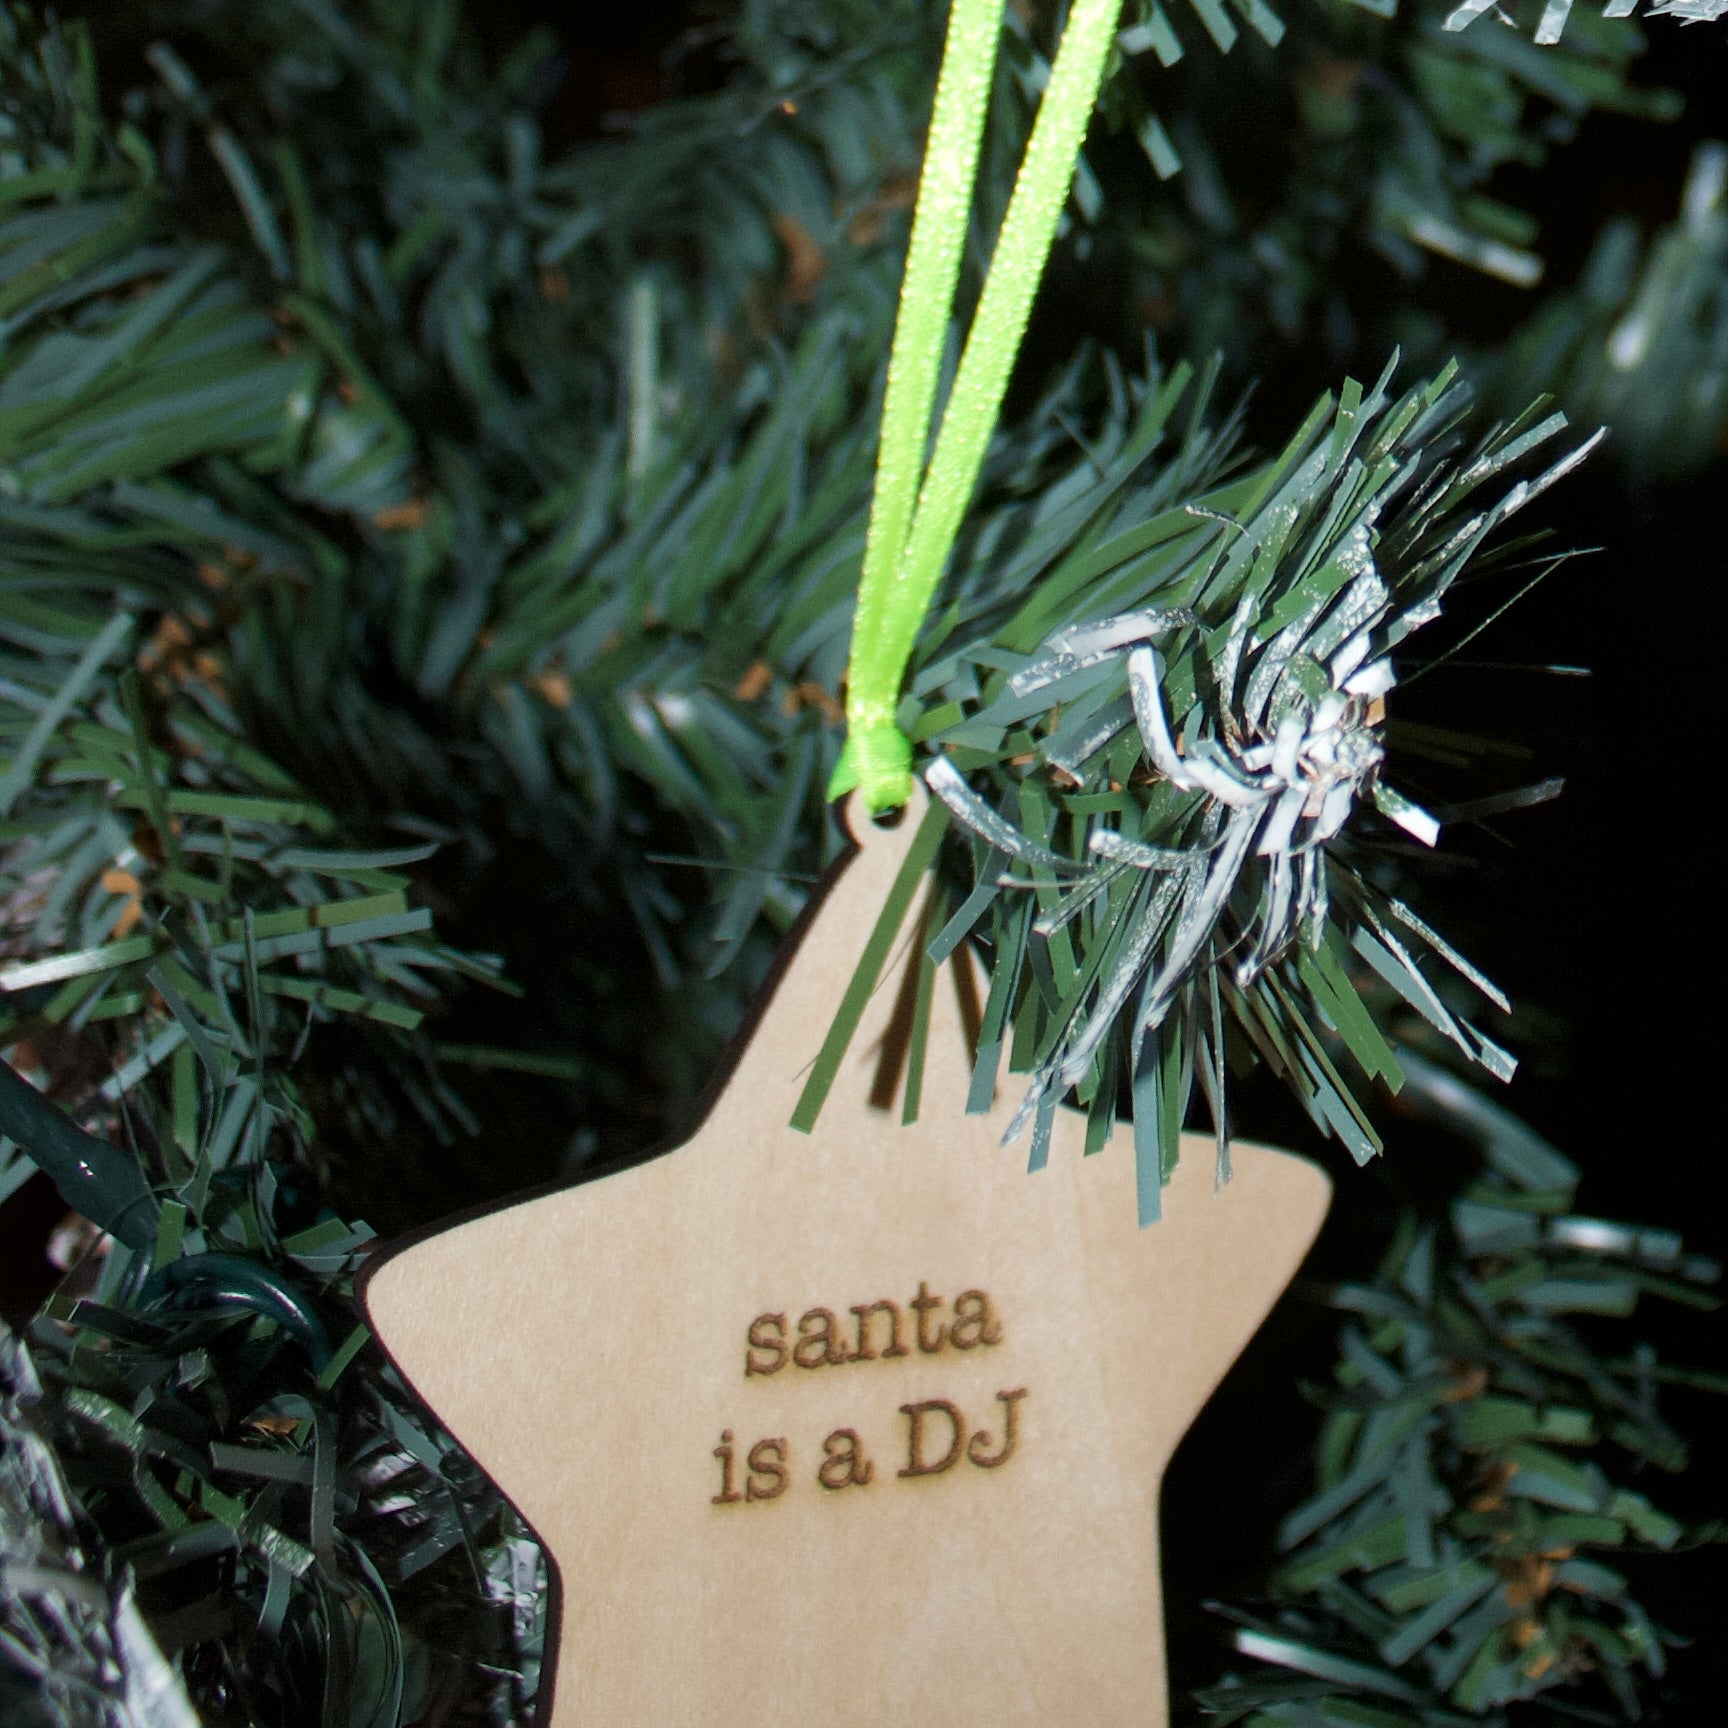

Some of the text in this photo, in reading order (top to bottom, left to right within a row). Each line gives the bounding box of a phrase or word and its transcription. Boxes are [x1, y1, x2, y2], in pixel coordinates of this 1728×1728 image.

[745, 1281, 1003, 1377] santa
[712, 1387, 1028, 1505] is a DJ
